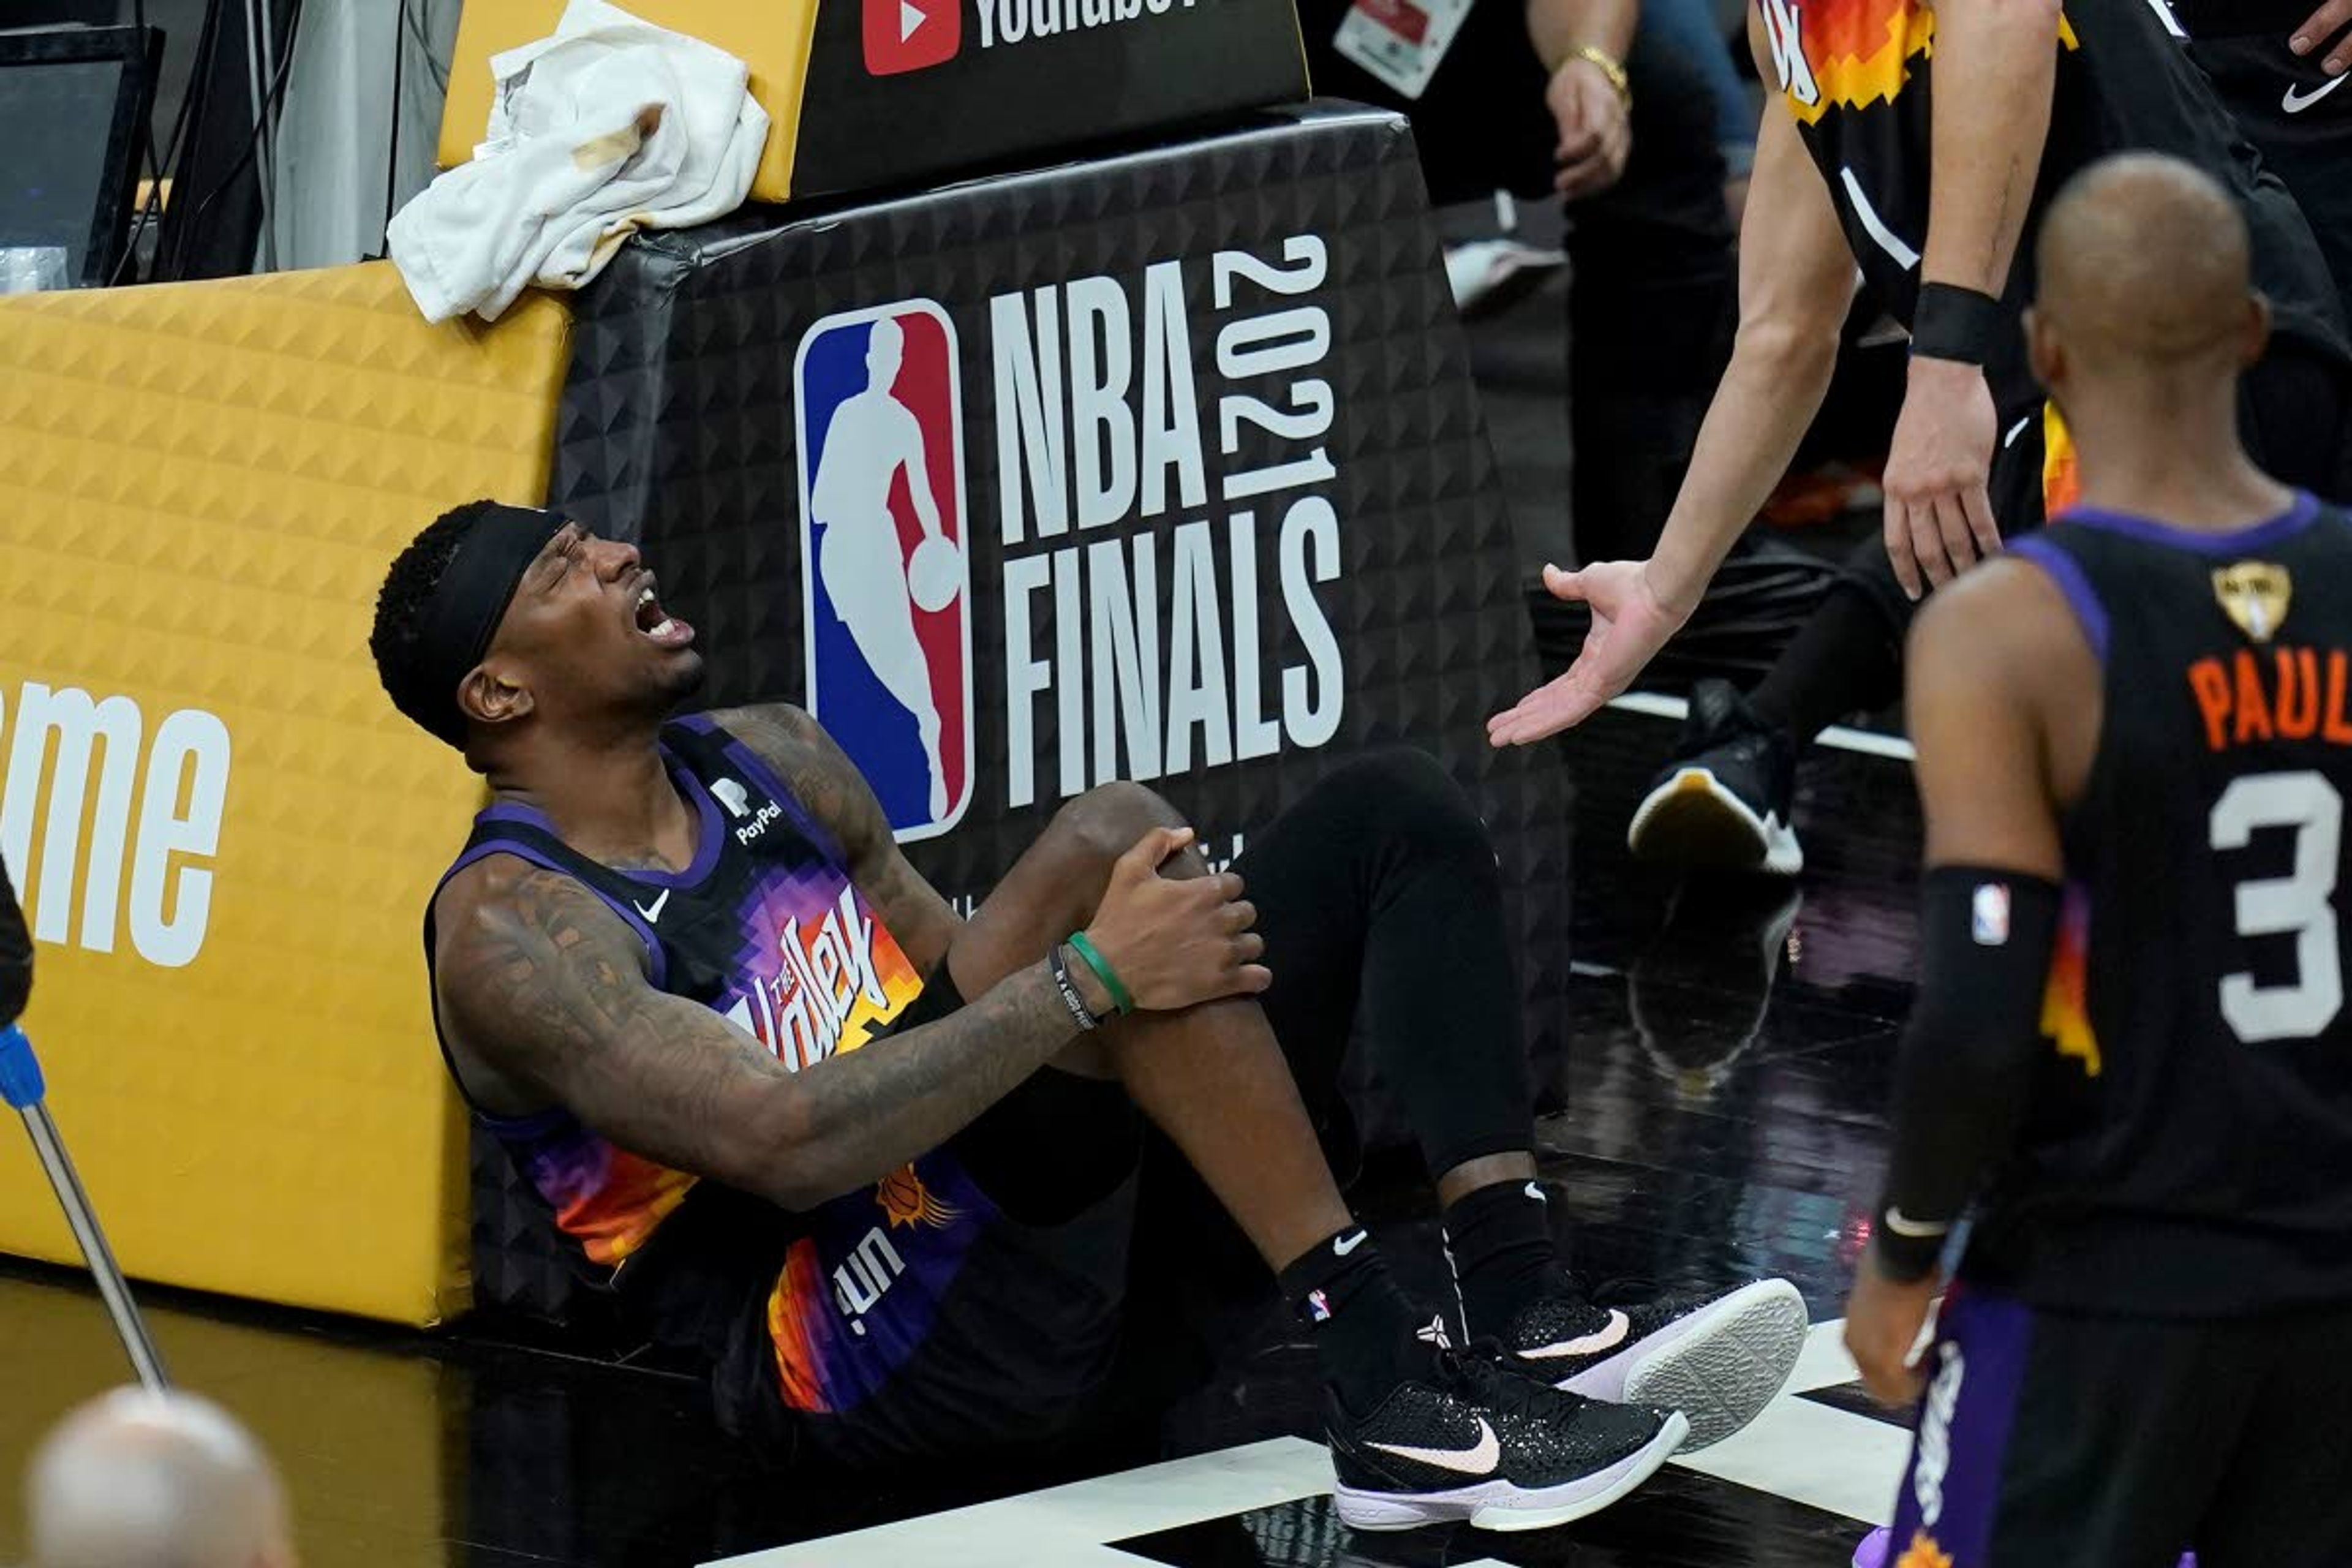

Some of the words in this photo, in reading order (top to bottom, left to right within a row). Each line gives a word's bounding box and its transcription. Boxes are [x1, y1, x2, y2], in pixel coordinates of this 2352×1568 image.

[990, 260, 1207, 545] NBA
[1213, 234, 1337, 500] 2021
[1003, 496, 1344, 808] FINALS
[2188, 646, 2352, 752] PAUL
[0, 681, 231, 968] me
[736, 799, 783, 846] PayPal
[2209, 769, 2343, 1043] 3
